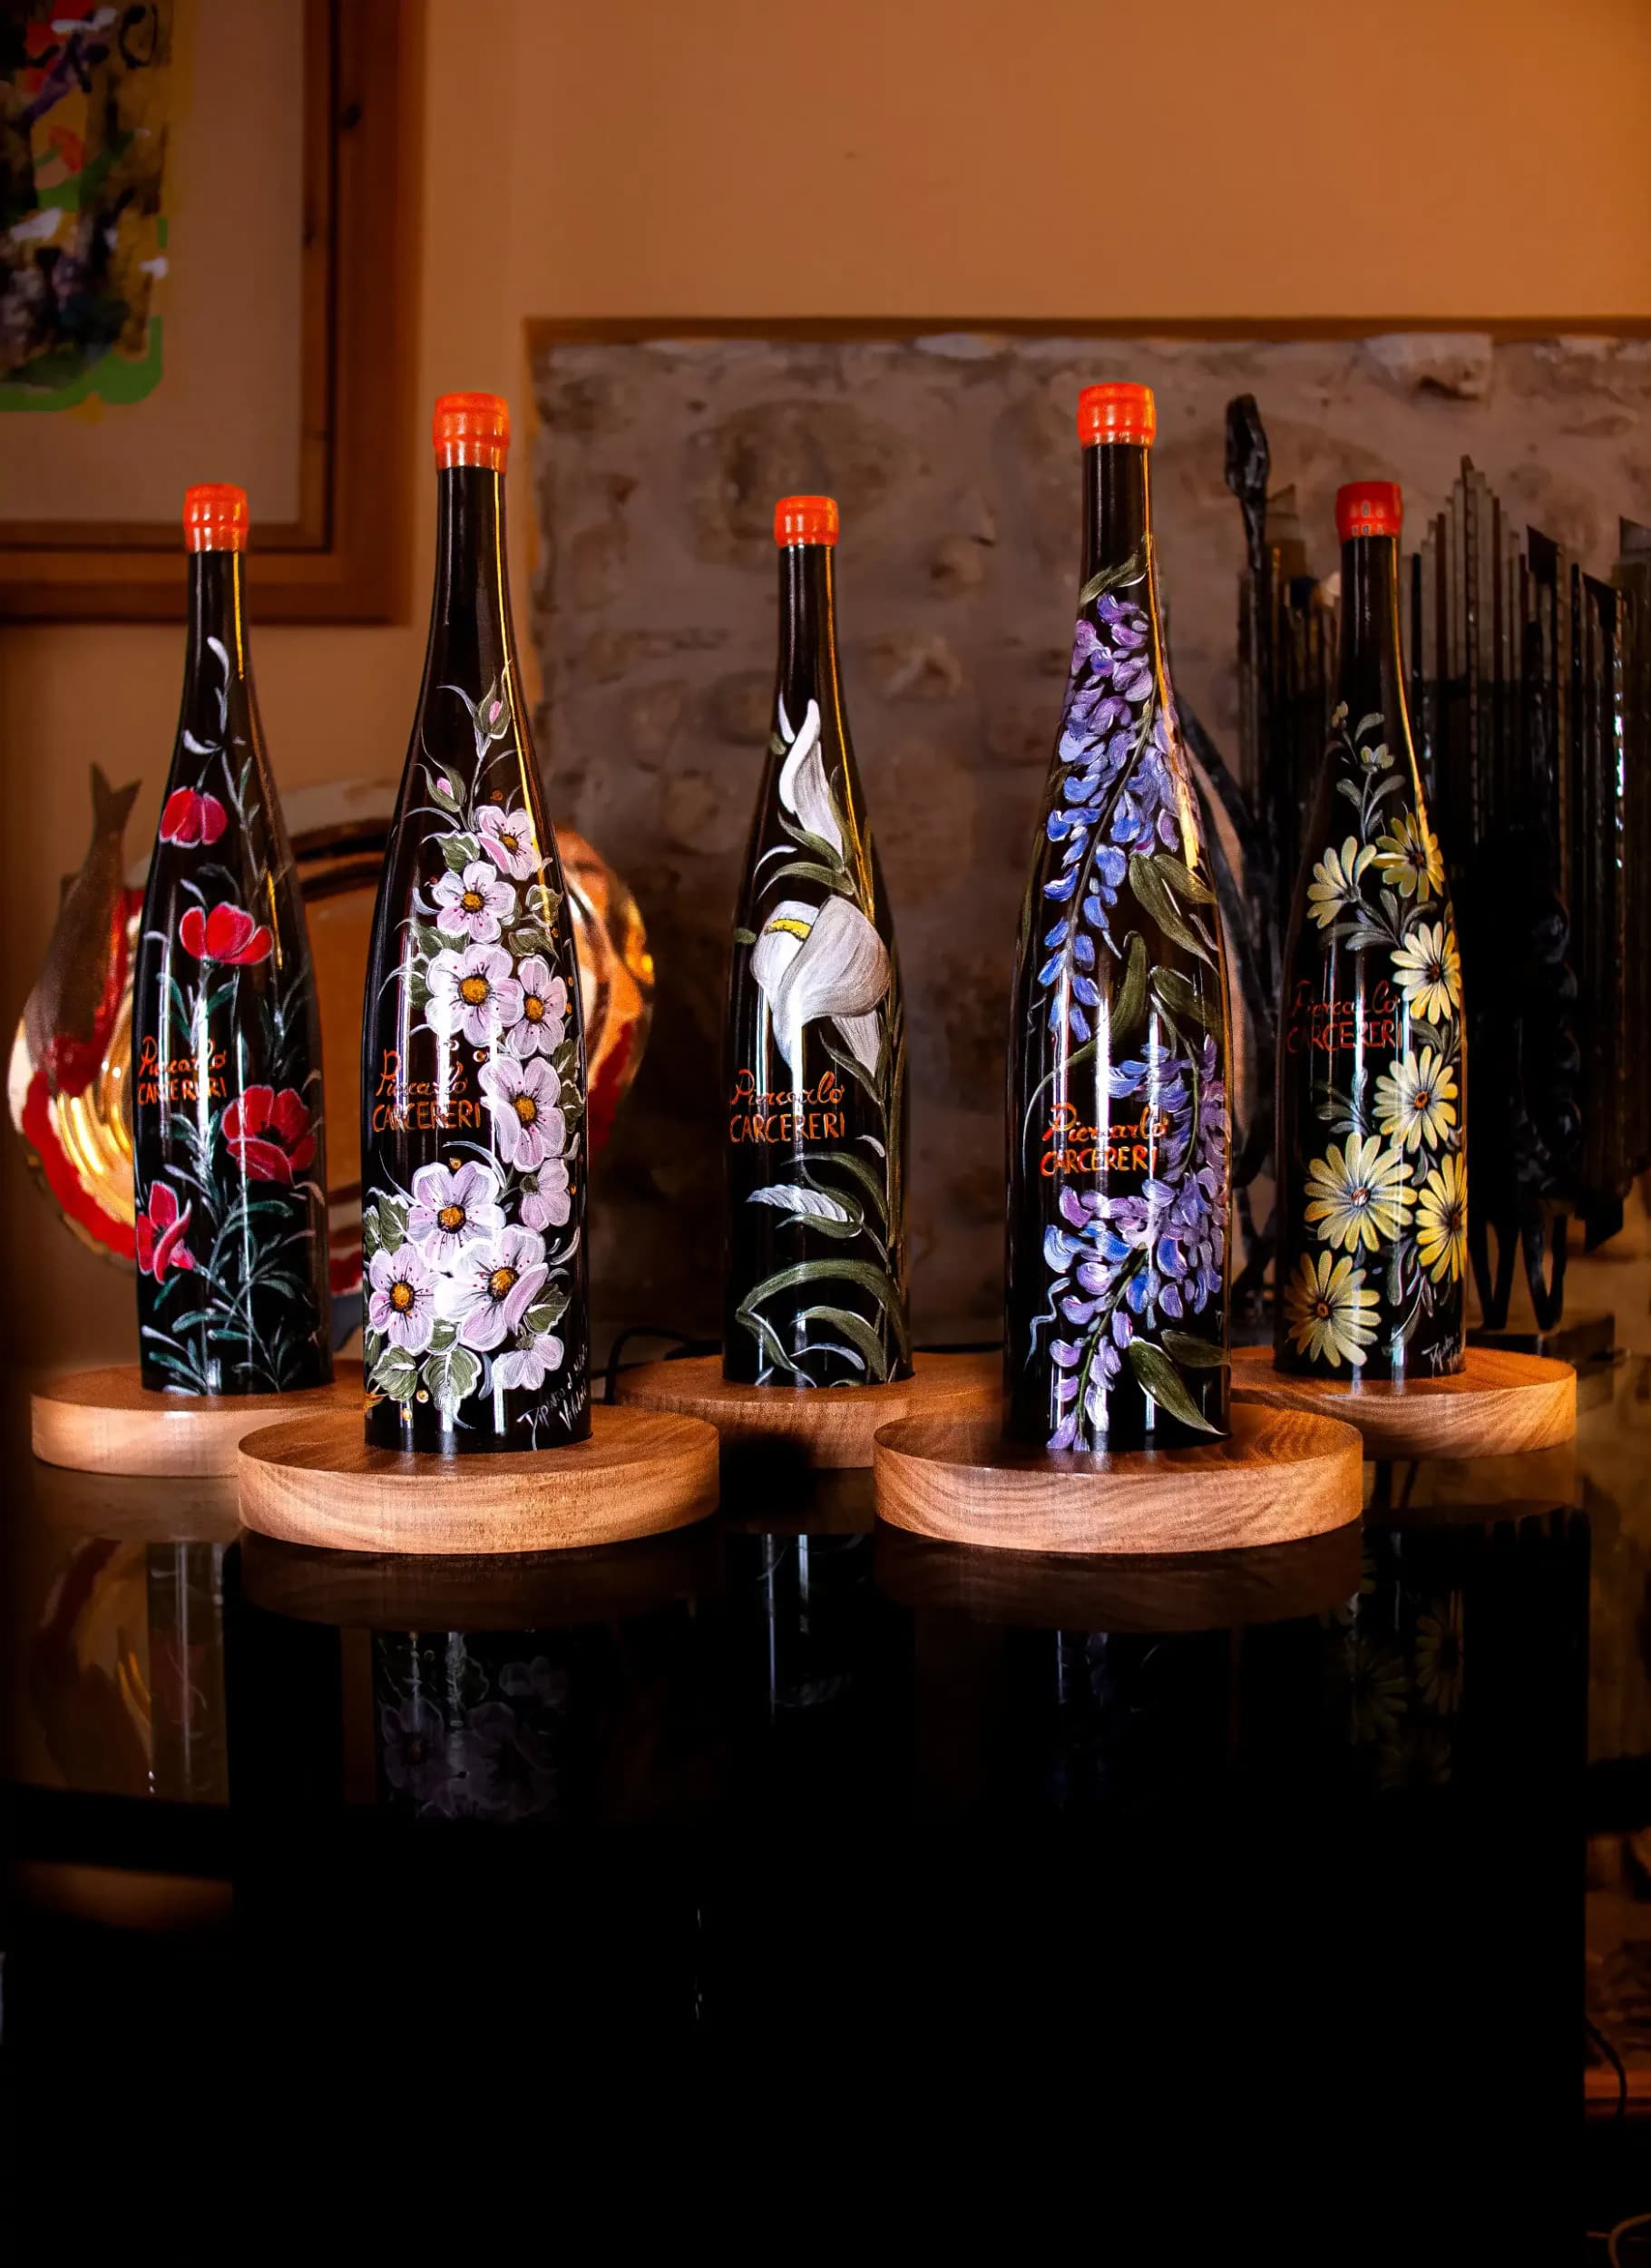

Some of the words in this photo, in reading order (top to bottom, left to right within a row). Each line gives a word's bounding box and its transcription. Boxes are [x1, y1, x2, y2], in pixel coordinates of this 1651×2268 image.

[137, 1076, 227, 1105] CARERRI
[729, 1110, 846, 1143] CARCERERI
[1041, 1101, 1169, 1142] Pierarlo
[1040, 1144, 1158, 1177] CARCERERI
